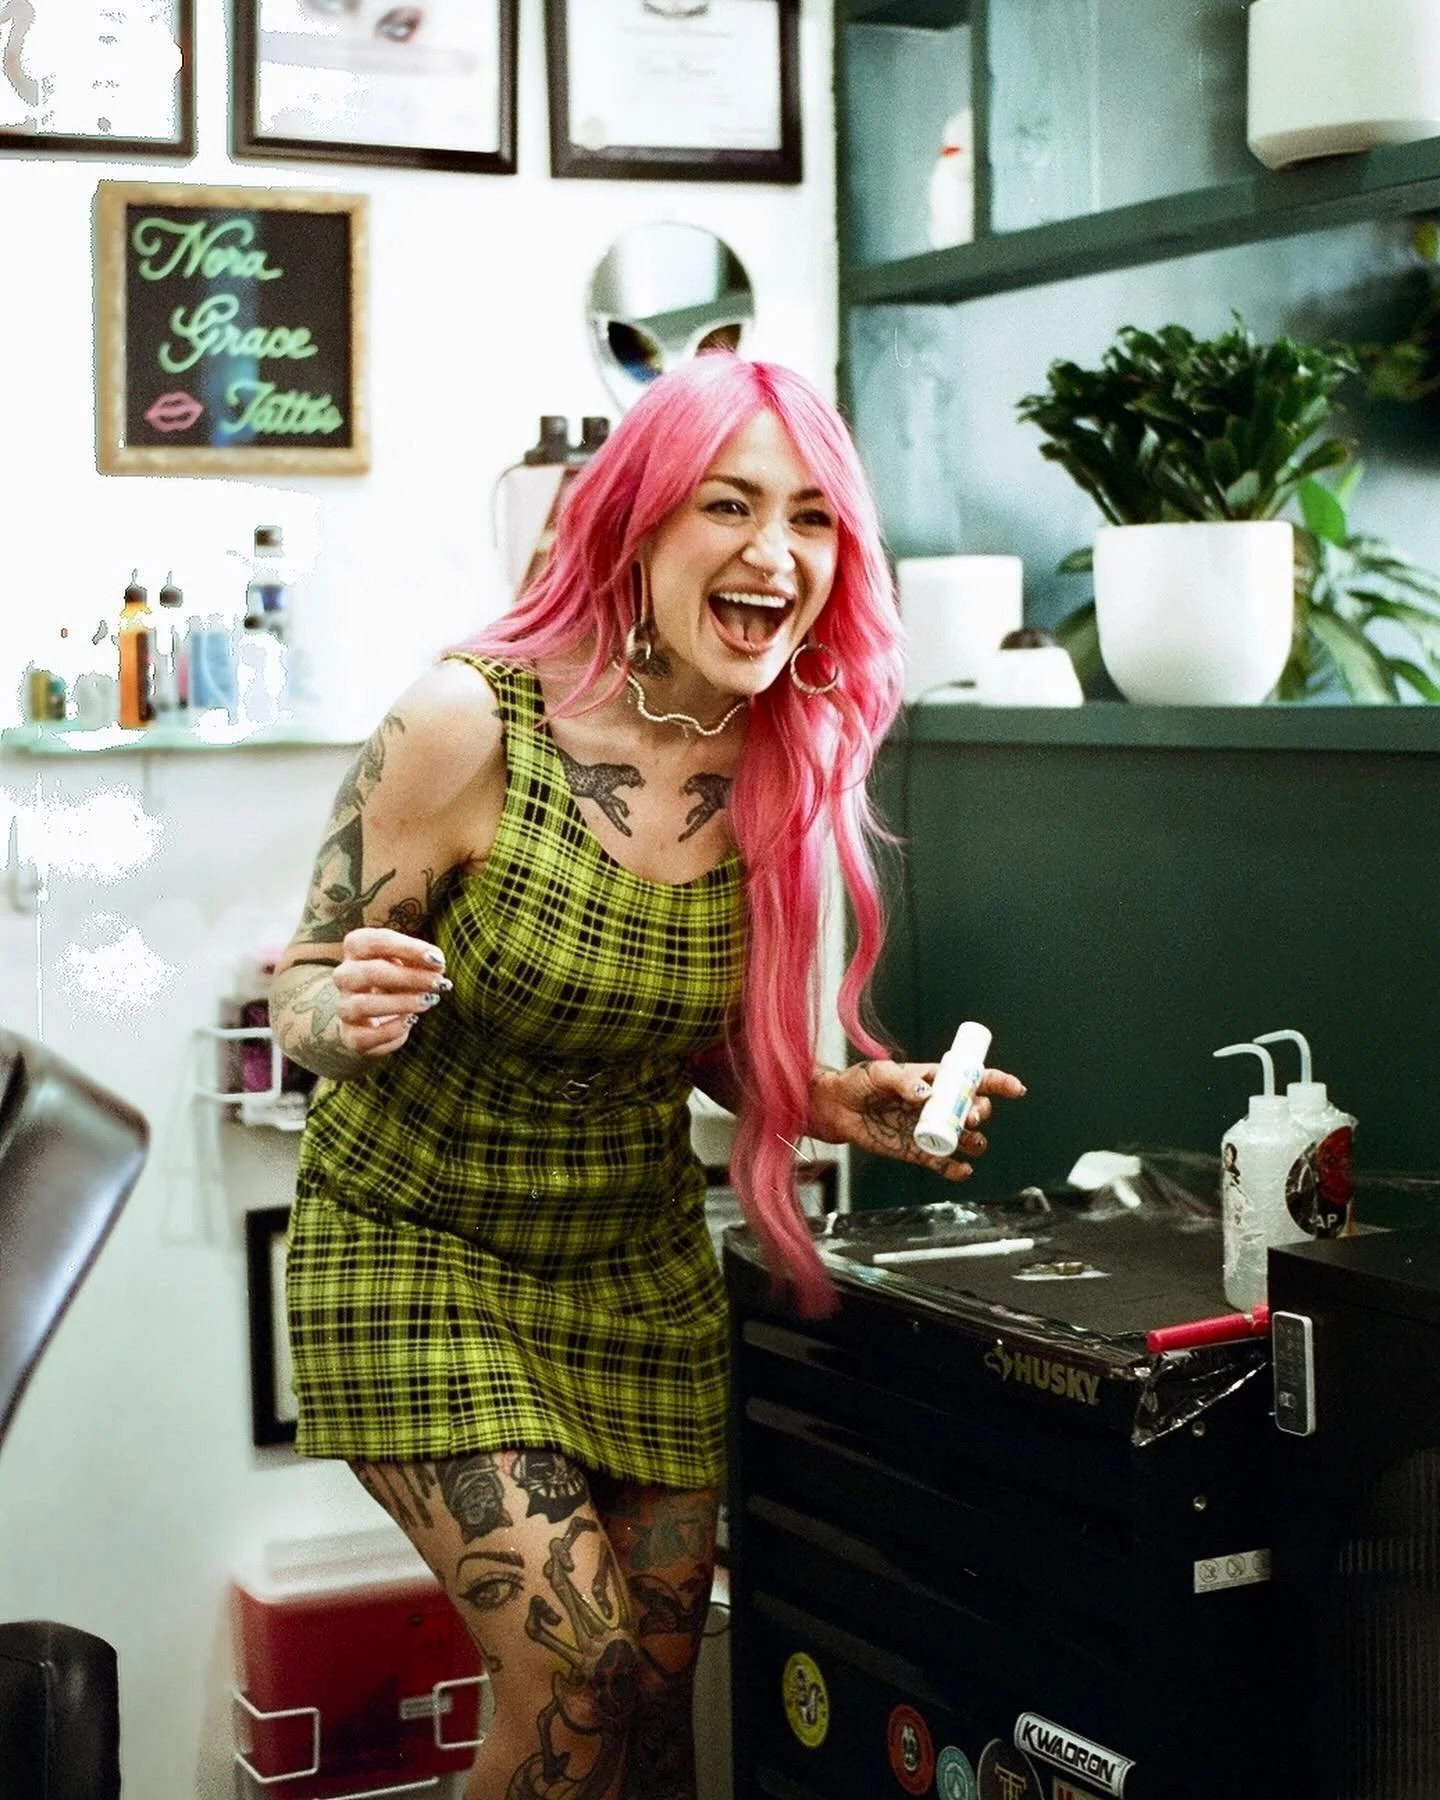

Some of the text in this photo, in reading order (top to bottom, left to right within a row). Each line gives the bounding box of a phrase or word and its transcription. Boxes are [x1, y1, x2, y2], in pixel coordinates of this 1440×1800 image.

[133, 217, 283, 281] Nora
[158, 293, 319, 374] Grace
[1013, 1351, 1101, 1406] HUSKY
[1021, 1720, 1117, 1783] KWADRON
